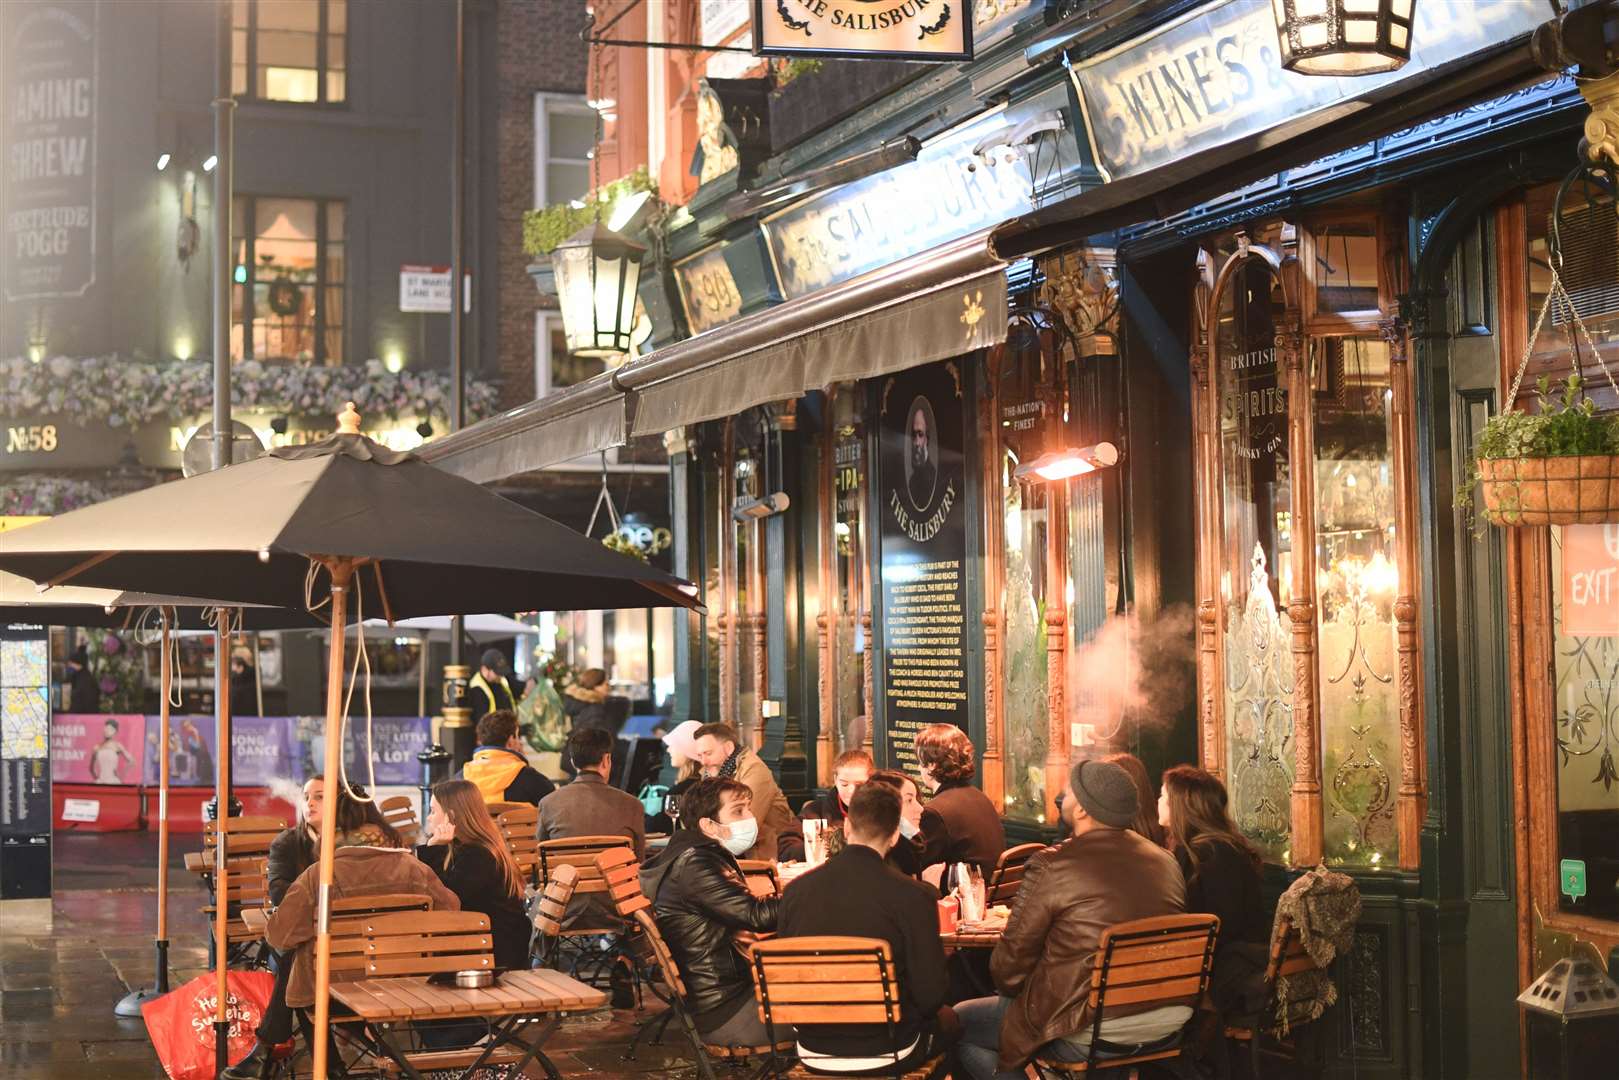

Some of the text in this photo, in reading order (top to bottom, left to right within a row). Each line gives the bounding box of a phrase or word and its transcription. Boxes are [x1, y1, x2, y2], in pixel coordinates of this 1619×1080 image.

[831, 0, 930, 30] SALISBUR
[14, 78, 88, 121] AMING
[1115, 35, 1255, 140] WINES
[16, 229, 69, 258] FOGG
[1230, 347, 1277, 370] BRITISH
[1004, 406, 1016, 417] THE
[1226, 388, 1285, 420] SPIRITS
[1013, 417, 1035, 432] FINEST
[1267, 434, 1282, 453] GIN
[841, 467, 858, 490] IPA
[890, 478, 955, 541] THE SALISBURY
[1571, 566, 1617, 606] EXIT
[52, 736, 72, 748] AN
[384, 750, 410, 763] LOT
[199, 991, 237, 1010] Helo
[191, 1006, 251, 1033] Swetie
